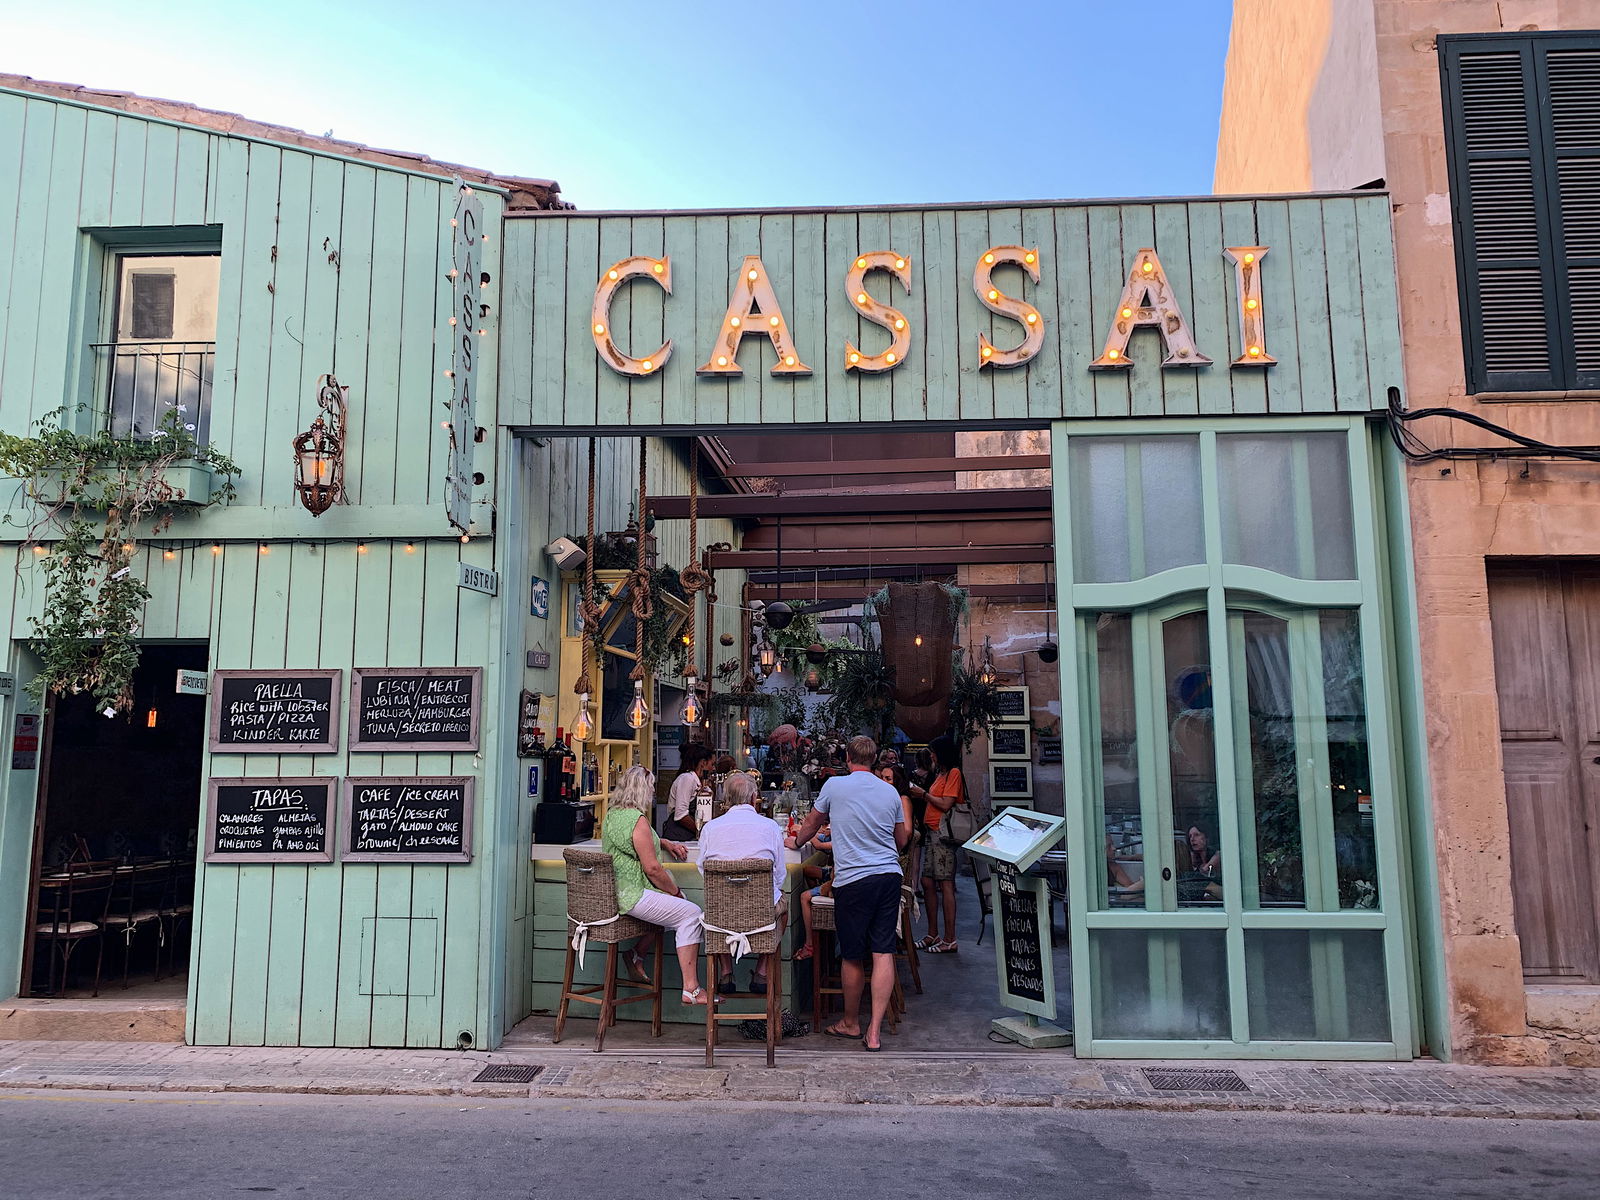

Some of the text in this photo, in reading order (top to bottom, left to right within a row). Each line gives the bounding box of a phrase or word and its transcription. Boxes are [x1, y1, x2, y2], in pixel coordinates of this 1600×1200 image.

[590, 245, 1278, 377] CASSAI
[461, 208, 476, 455] CASSAI
[464, 568, 494, 590] BISTRO
[254, 683, 303, 701] PAELLA
[427, 679, 463, 692] MEAT
[230, 714, 265, 726] PASTA
[277, 712, 315, 724] PIZZA
[289, 728, 320, 740] KARTE
[252, 788, 304, 808] TAPAS
[360, 788, 391, 803] CAFE
[424, 789, 459, 801] CREAM
[219, 813, 264, 824] CALAMARES
[219, 825, 265, 835] CROQUETAS
[398, 822, 433, 832] ALMOND
[436, 822, 459, 832] CAKE
[1000, 879, 1016, 894] OPEN
[1010, 938, 1037, 955] TAPAS
